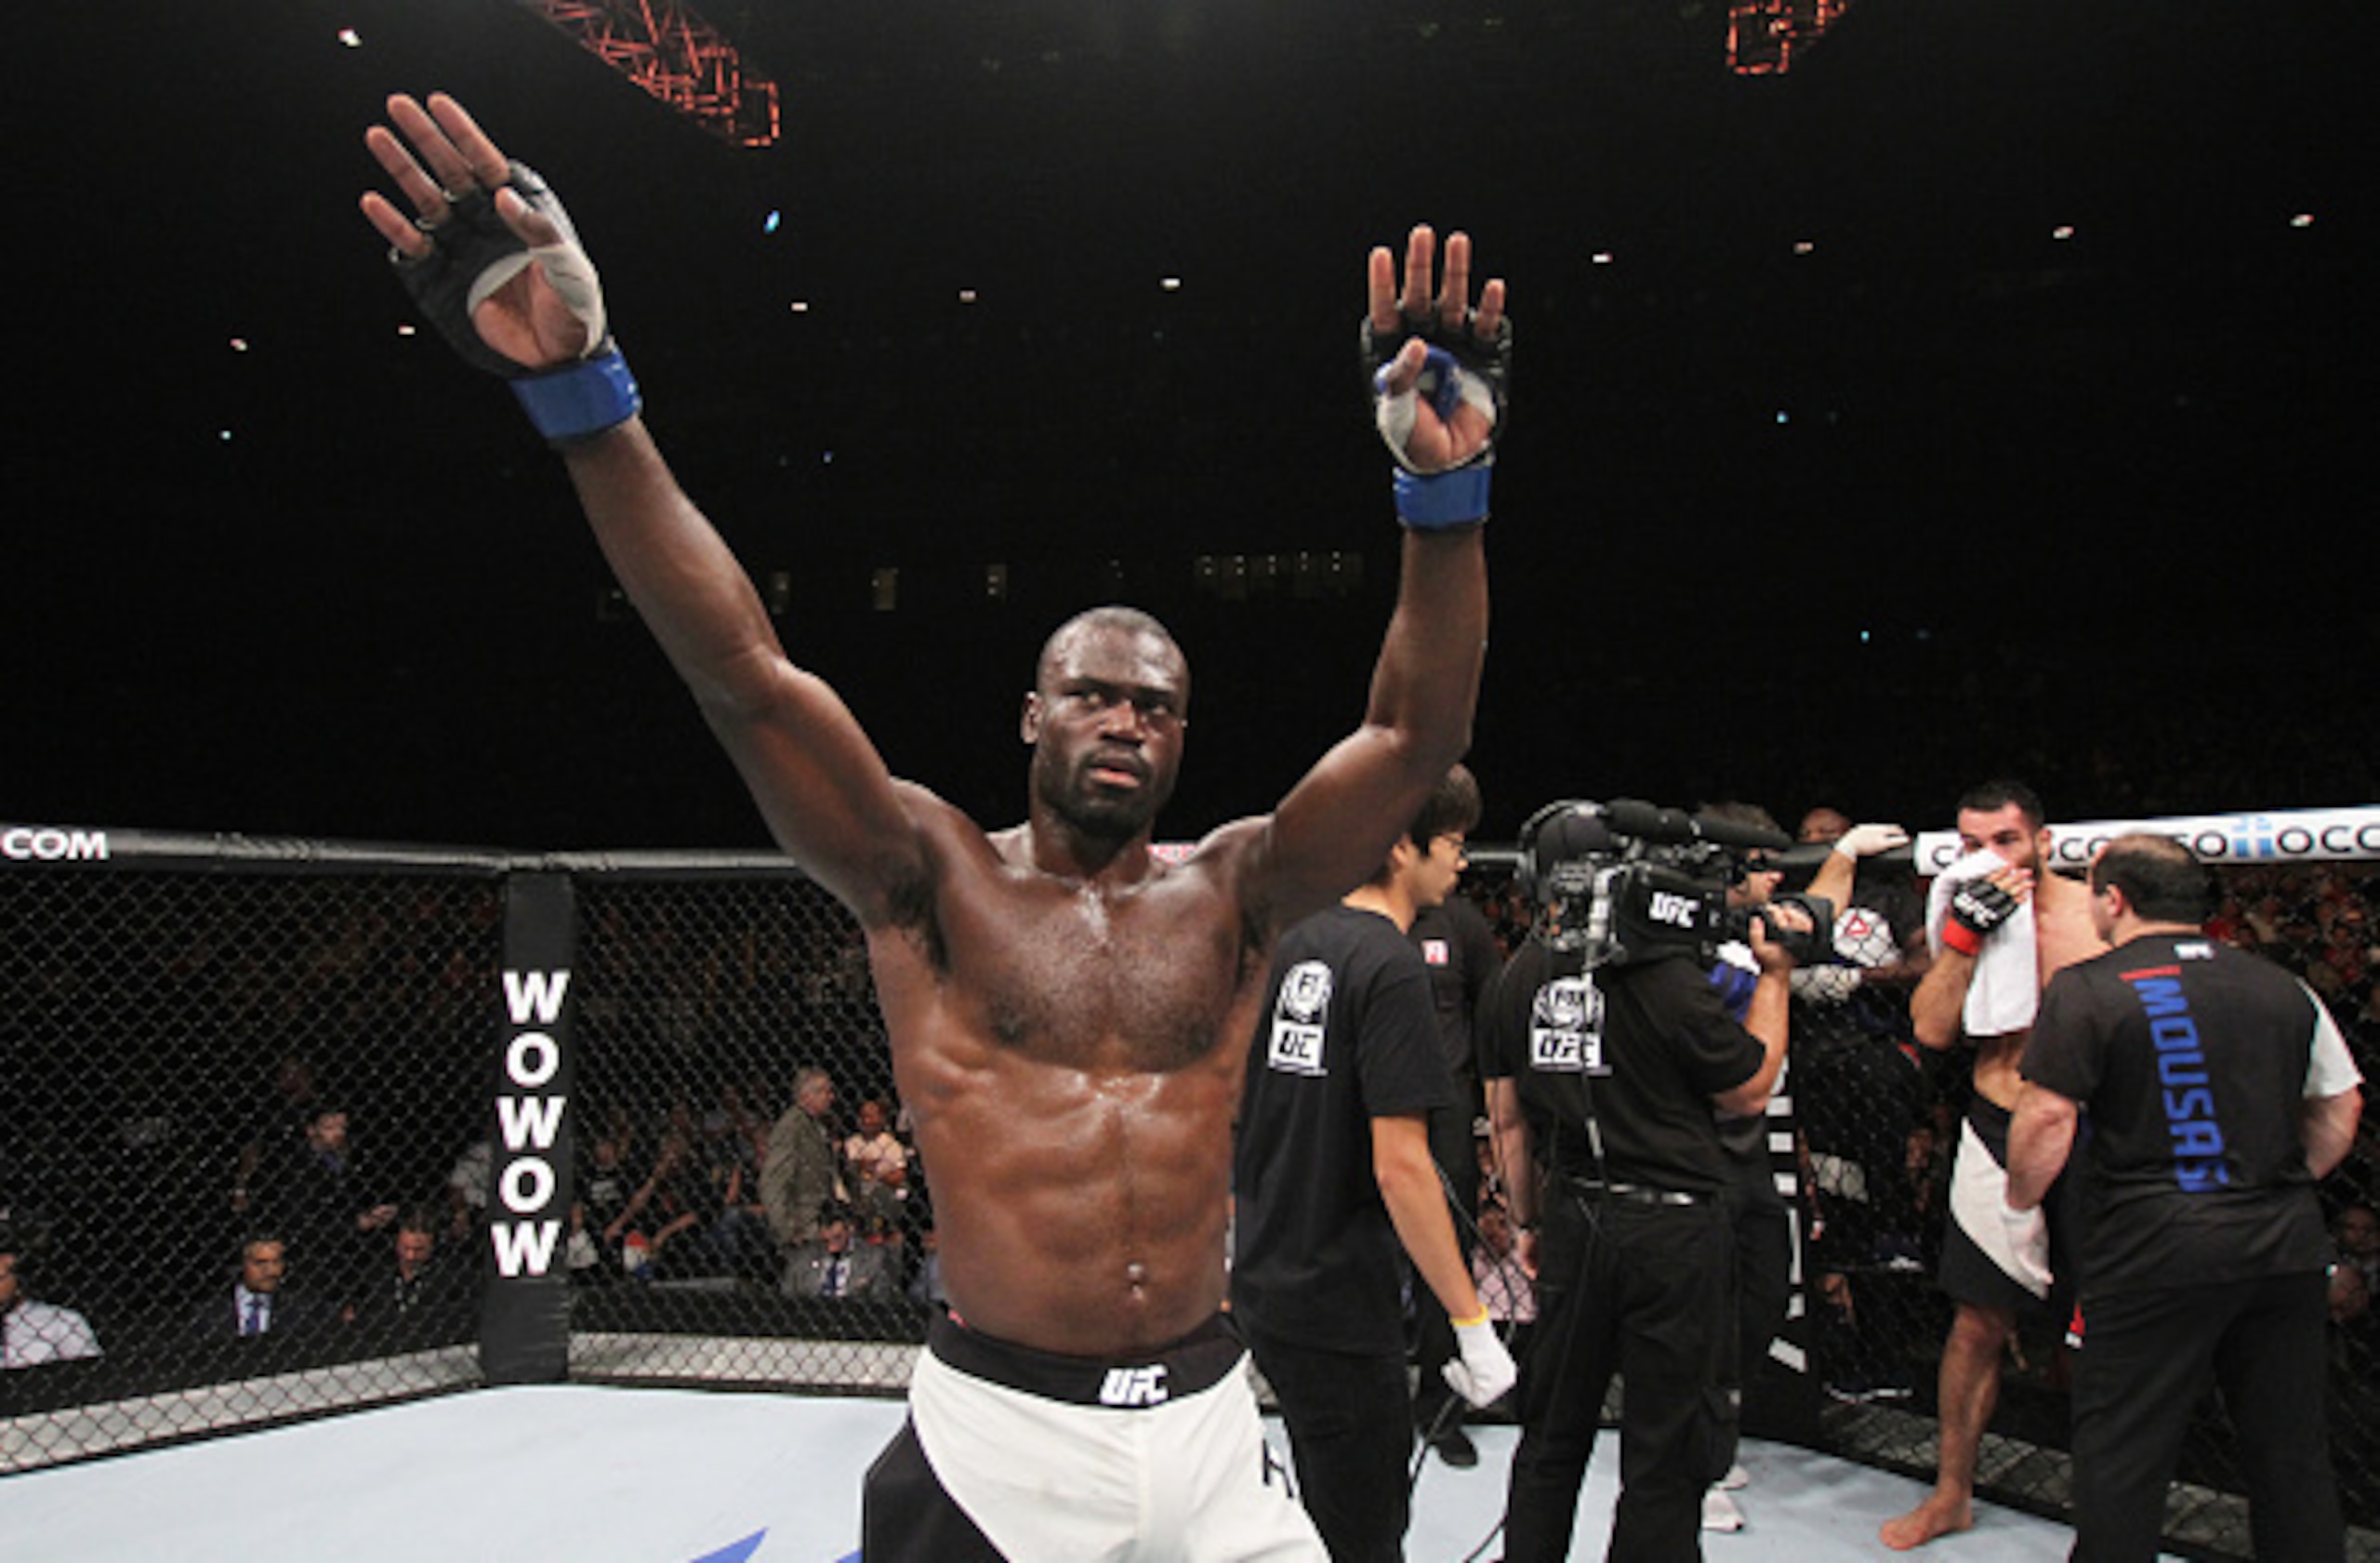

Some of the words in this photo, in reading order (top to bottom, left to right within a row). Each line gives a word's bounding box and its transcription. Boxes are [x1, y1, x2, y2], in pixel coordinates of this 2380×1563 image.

[1, 828, 110, 860] COM
[1648, 891, 1701, 928] UFC
[2134, 977, 2229, 1192] MOUSAS
[491, 971, 571, 1277] WOWOW
[1099, 1364, 1169, 1404] UFC
